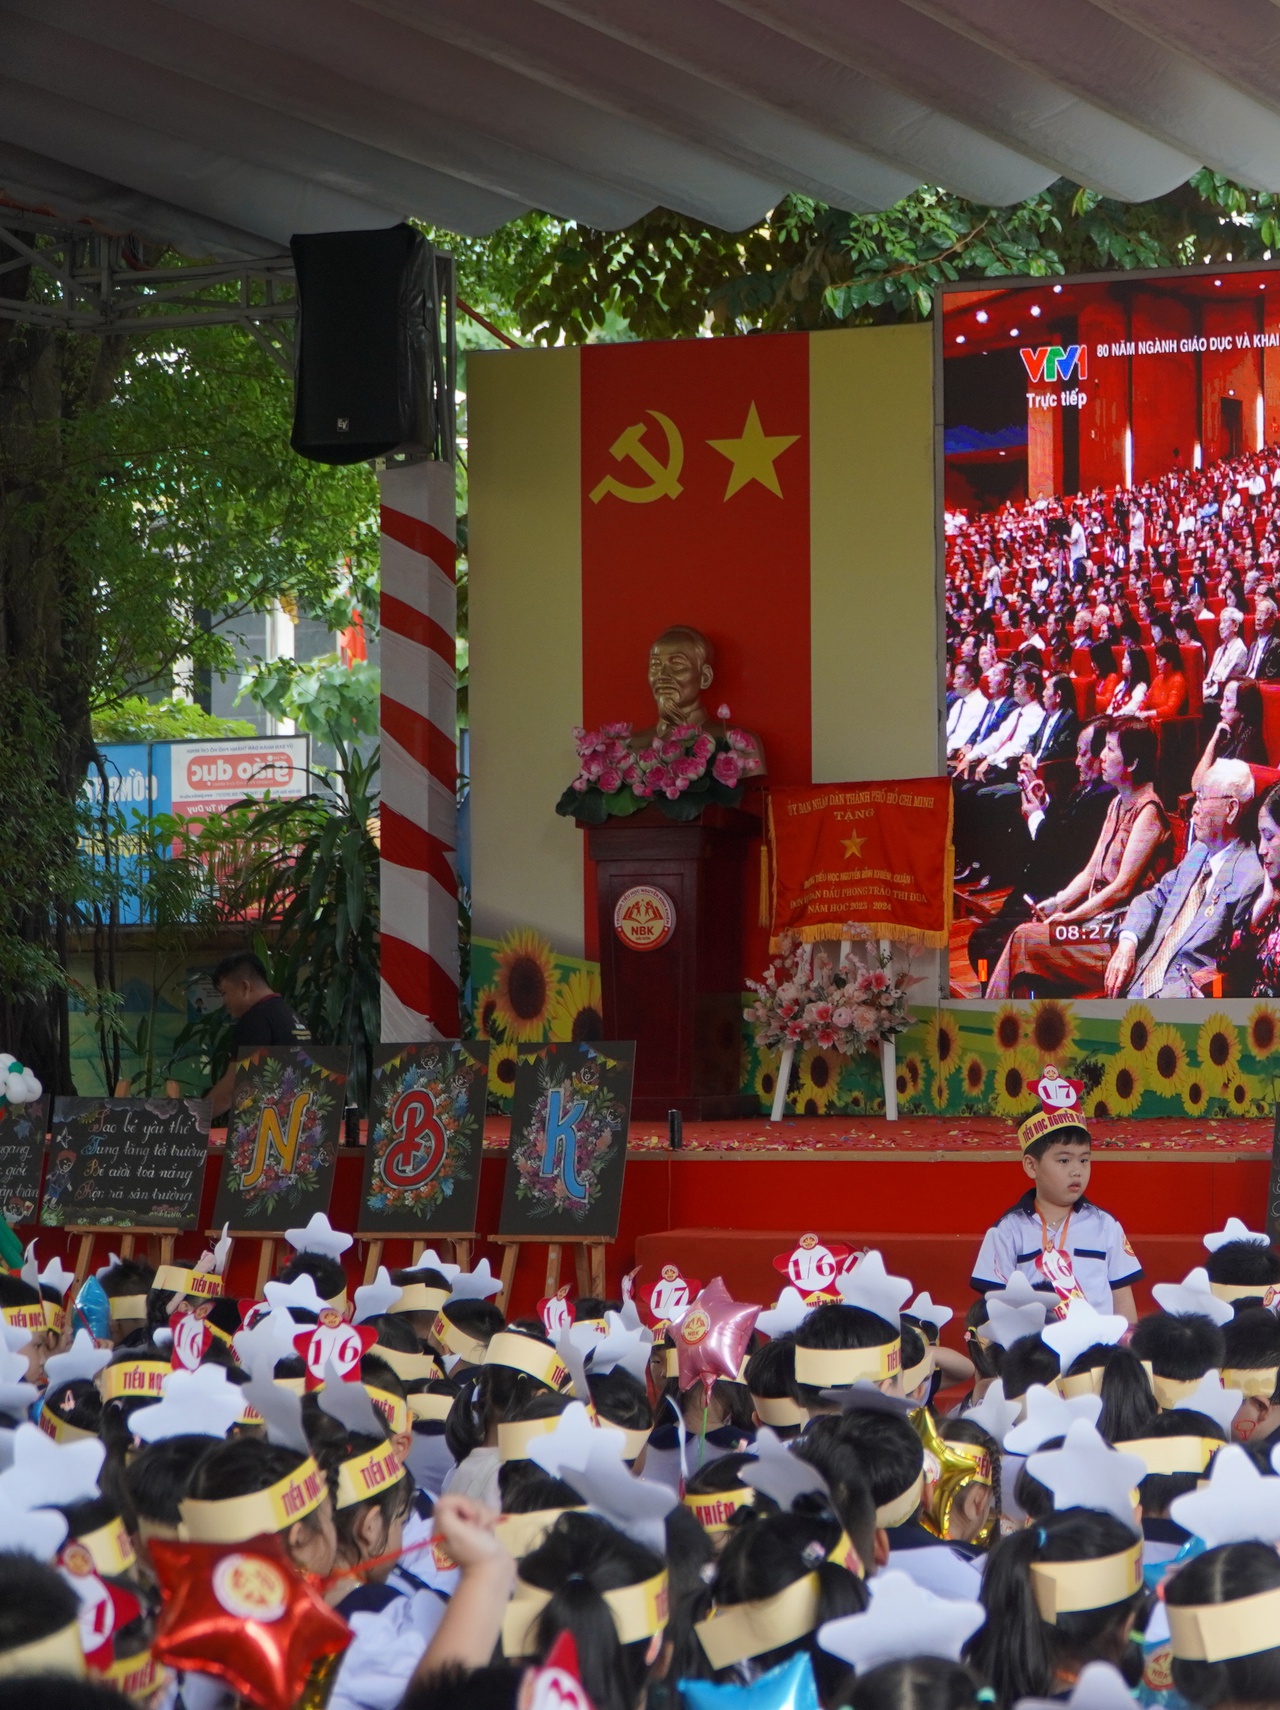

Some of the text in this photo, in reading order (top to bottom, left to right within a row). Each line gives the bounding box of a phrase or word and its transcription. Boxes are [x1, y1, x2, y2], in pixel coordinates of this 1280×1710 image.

[1097, 344, 1109, 358] 80
[1111, 340, 1135, 357] NĂM
[1138, 337, 1177, 355] NGÀNH
[1180, 335, 1207, 353] GIÁO
[1209, 335, 1233, 352] DỤC
[1235, 332, 1251, 348] VÀ
[1253, 332, 1280, 348] KHAI
[1020, 344, 1088, 382] VTV1
[1026, 388, 1087, 410] Trực tiếp
[913, 796, 934, 808] MINH
[834, 808, 875, 822] TẶNG
[893, 890, 909, 900] THI
[808, 902, 828, 914] NĂM
[830, 903, 850, 914] HỌC
[631, 926, 655, 936] NBK
[1054, 924, 1112, 942] 08:27
[1040, 1084, 1071, 1100] 1/7
[124, 1111, 138, 1133] bé
[381, 1087, 447, 1191] B
[541, 1089, 589, 1202] K
[789, 1253, 836, 1282] 1/6
[653, 1286, 690, 1310] 1/7
[175, 1320, 204, 1360] 1/6
[309, 1335, 360, 1367] 1/6
